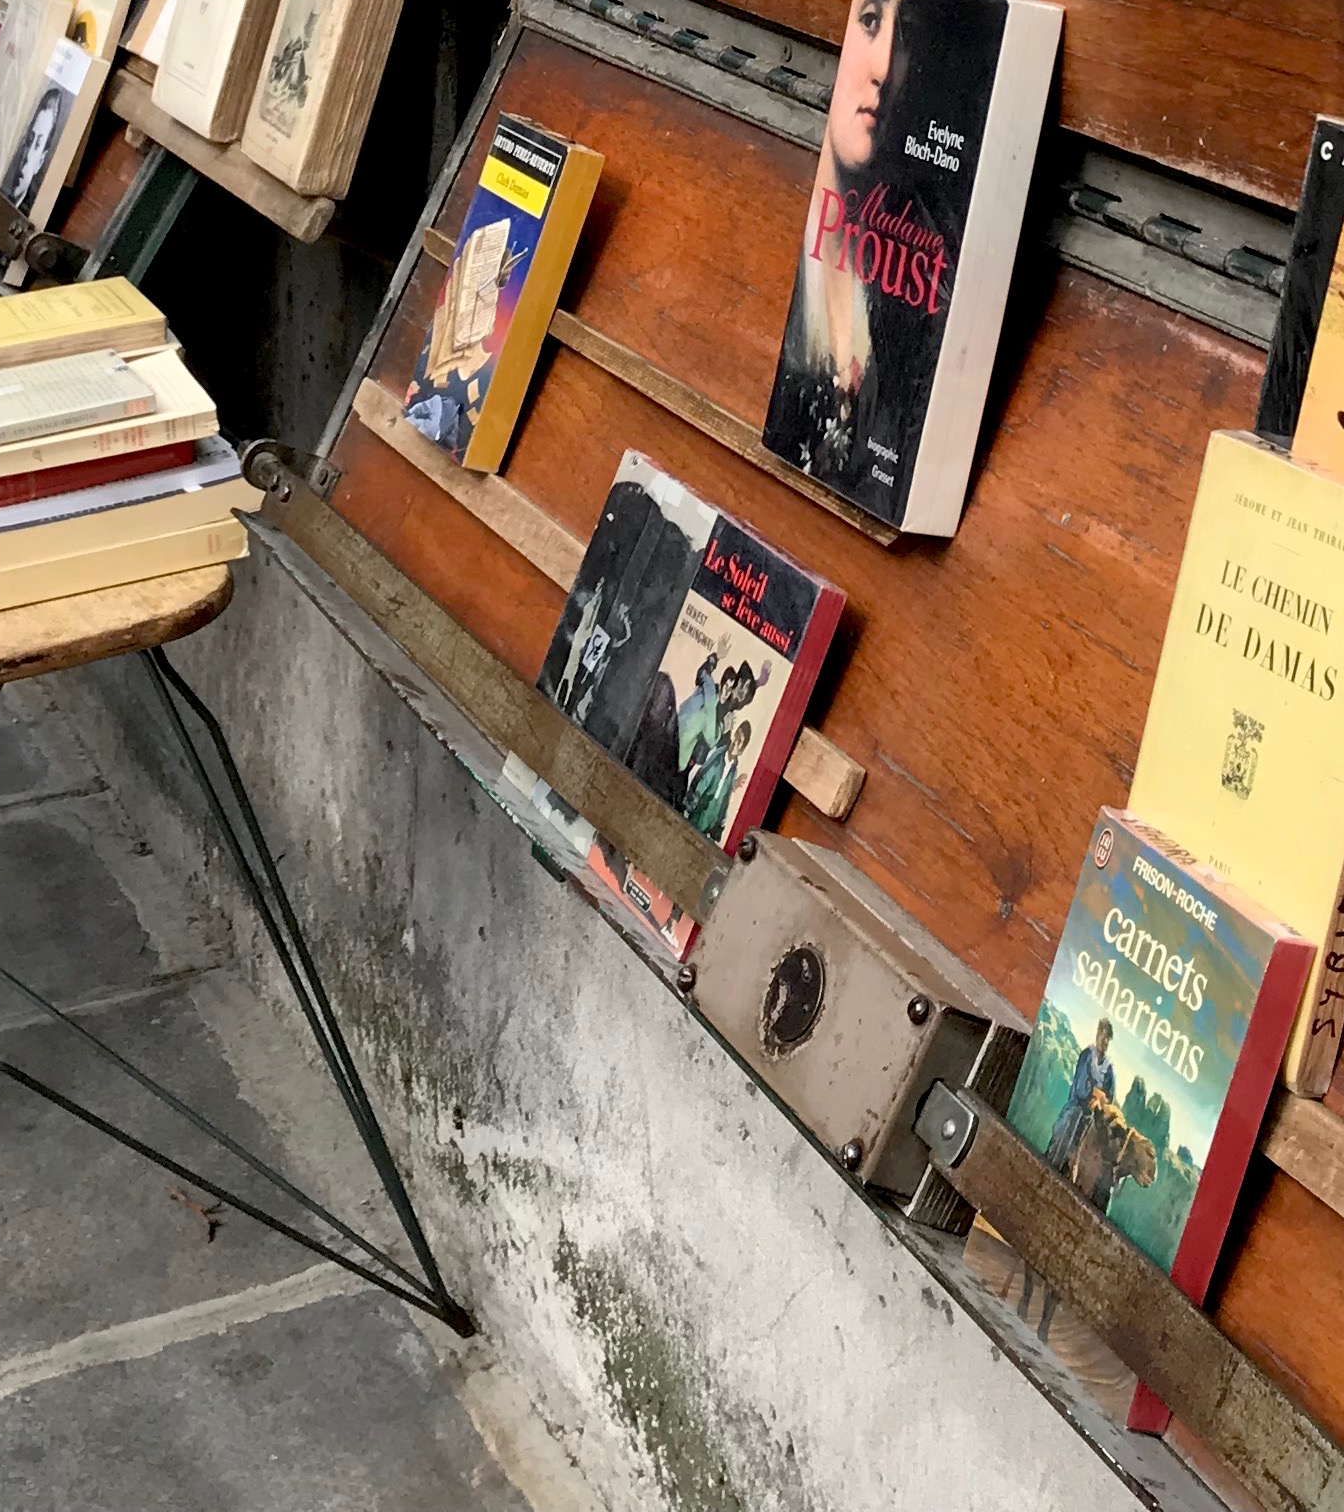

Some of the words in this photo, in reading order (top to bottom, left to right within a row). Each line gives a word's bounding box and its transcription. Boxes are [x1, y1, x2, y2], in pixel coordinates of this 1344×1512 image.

[493, 133, 513, 157] ARTURO
[513, 141, 557, 178] PEREZ-REVERTE
[904, 136, 960, 174] Bloch-Dano
[927, 119, 965, 152] Evelyne
[495, 171, 509, 187] Club
[509, 178, 530, 201] Dumas
[844, 181, 945, 255] Madame
[808, 186, 948, 316] Proust
[866, 437, 900, 467] biographie
[871, 464, 895, 488] Grasset
[1286, 515, 1310, 535] JEAN
[704, 537, 726, 574] Le
[724, 555, 771, 605] Soleil
[683, 603, 709, 628] ERNEST
[1220, 559, 1246, 592] LE
[1251, 575, 1335, 638] CHEMIN
[678, 616, 716, 652] HEMINGWAY
[719, 591, 736, 612] se
[736, 595, 762, 630] lève
[759, 620, 794, 655] aussi
[1195, 602, 1230, 648] DE
[1242, 627, 1340, 704] DAMAS
[1208, 854, 1233, 878] PARIS
[1131, 854, 1219, 934] FRISON-ROCHE
[1102, 905, 1209, 1013] carnets
[1071, 948, 1206, 1084] sahariens
